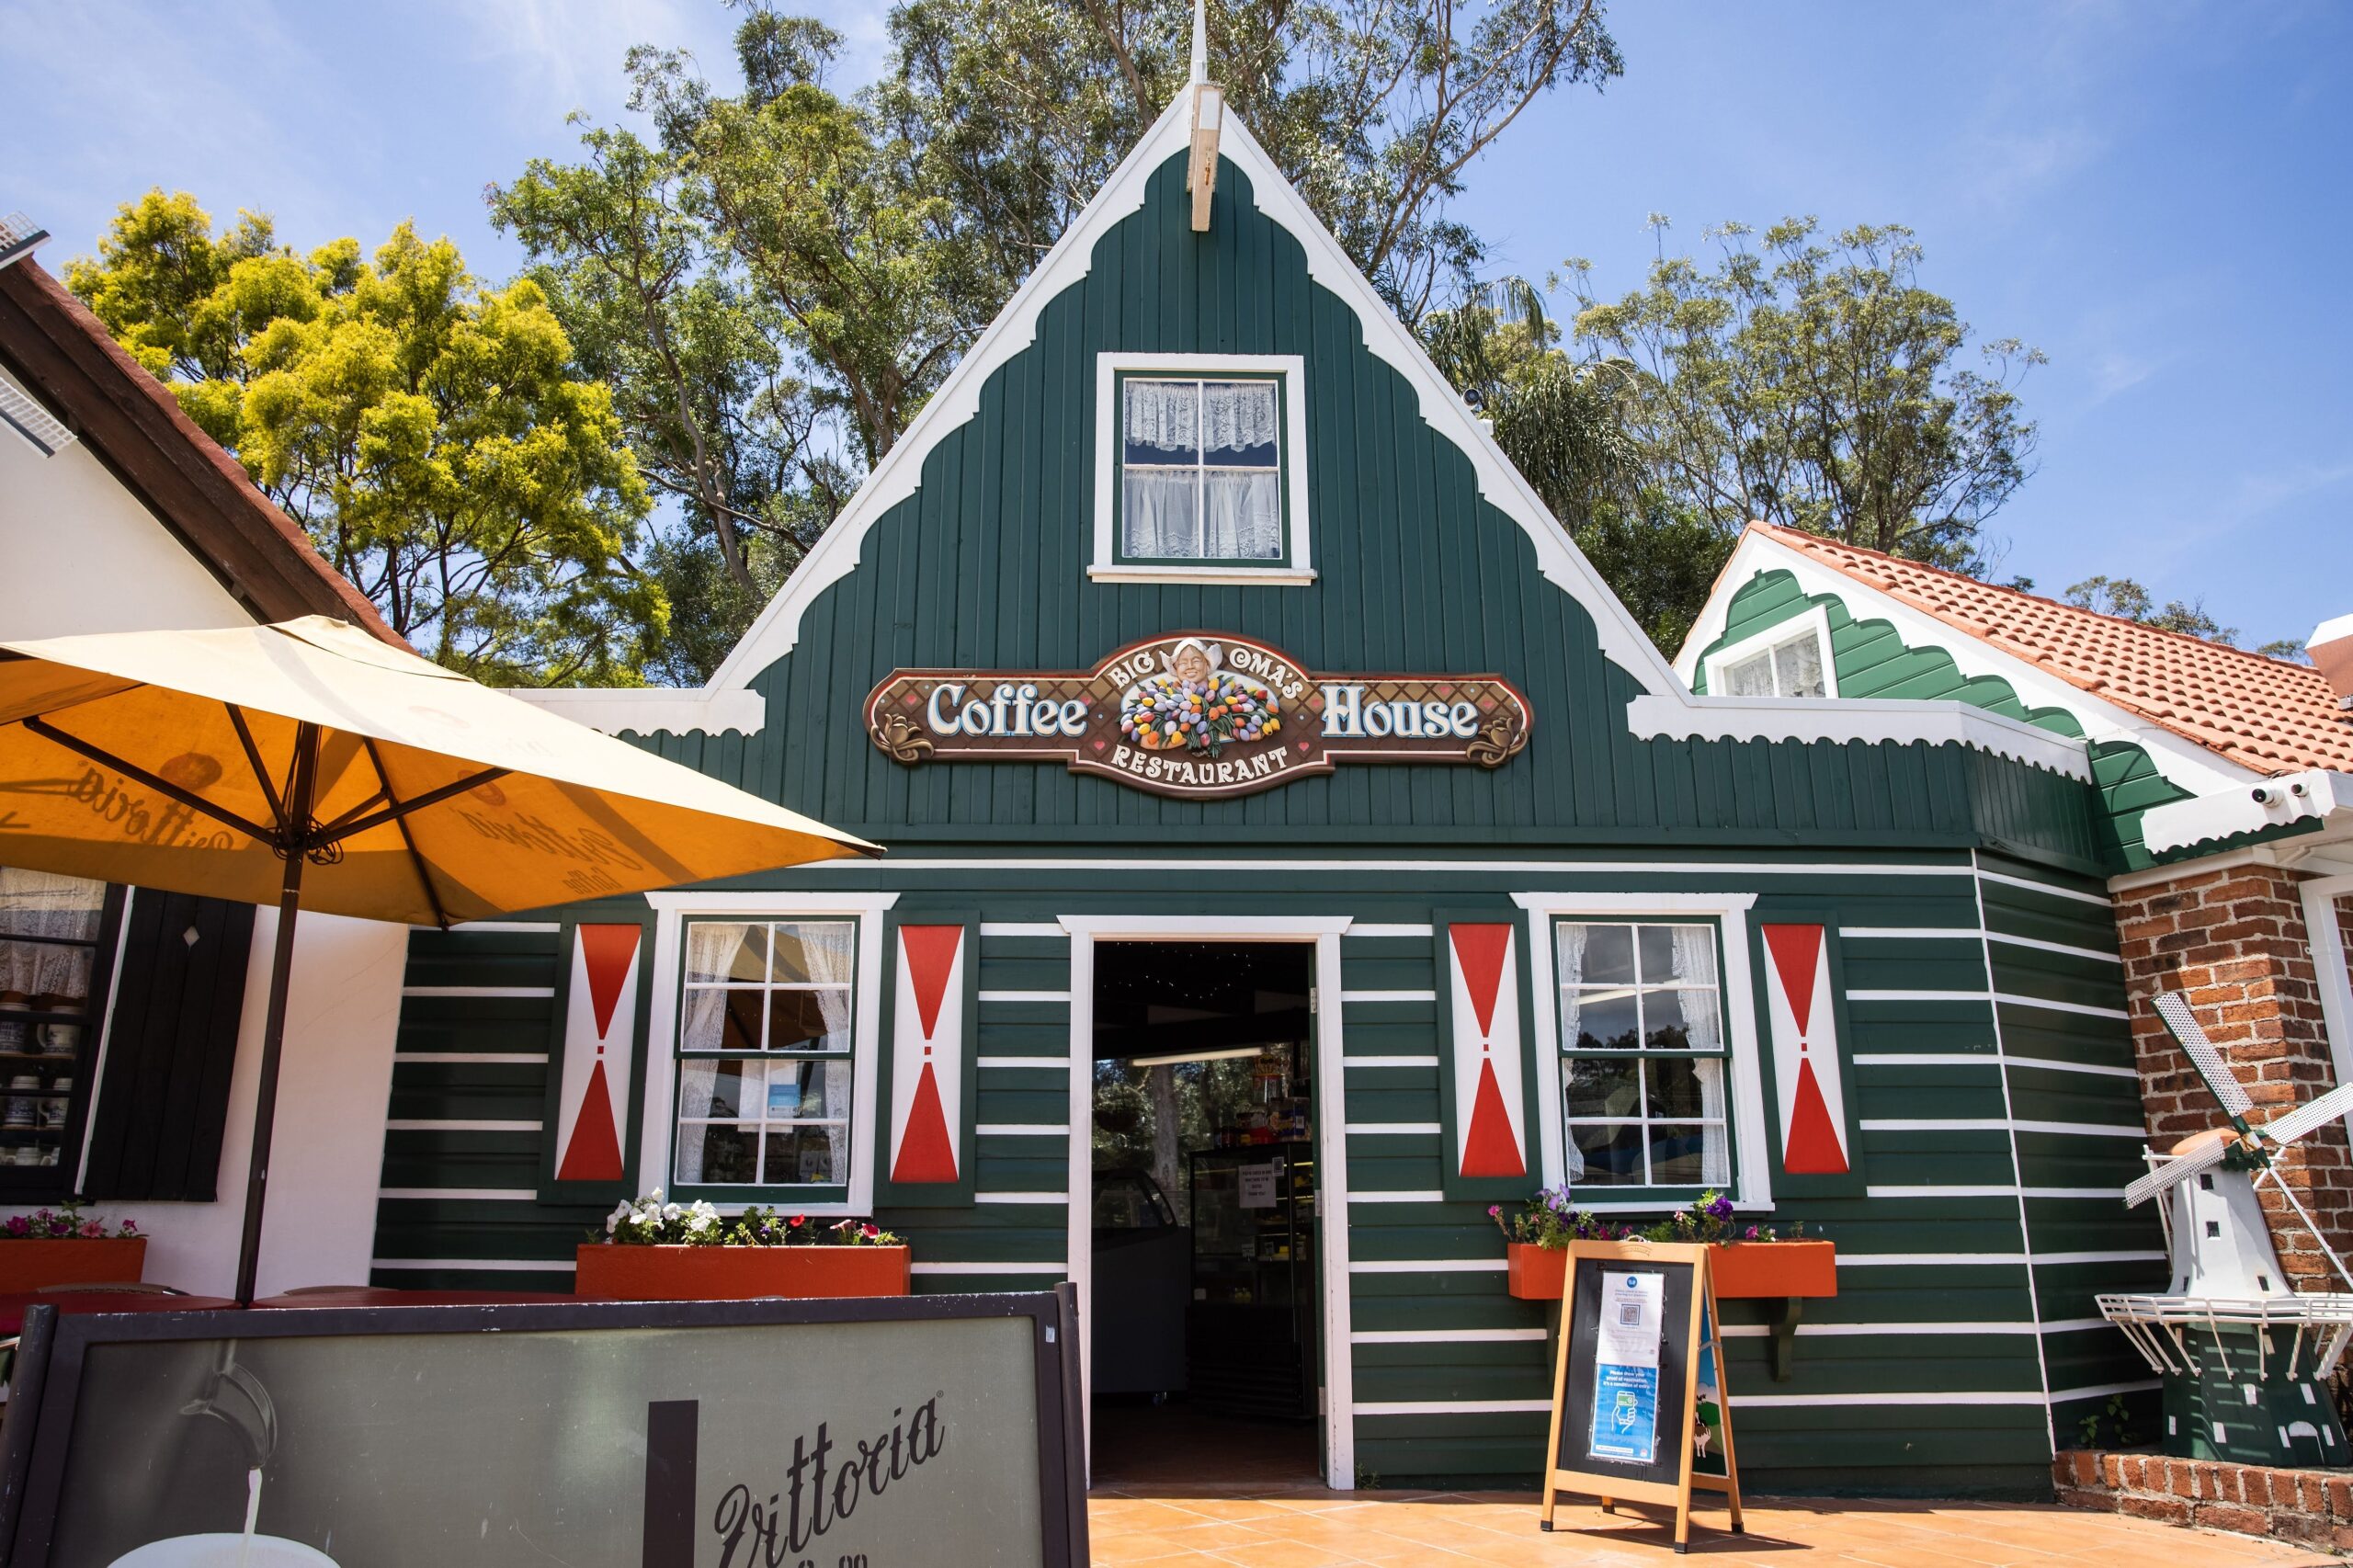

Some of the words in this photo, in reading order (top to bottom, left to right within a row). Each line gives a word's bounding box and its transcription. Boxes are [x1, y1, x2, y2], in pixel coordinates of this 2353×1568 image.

[1108, 651, 1155, 689] BIG
[1229, 647, 1303, 699] OMA'S
[926, 683, 1088, 737] Coffee
[1321, 686, 1479, 738] House
[1110, 744, 1288, 785] RESTAURANT
[714, 1396, 945, 1568] Vittoria
